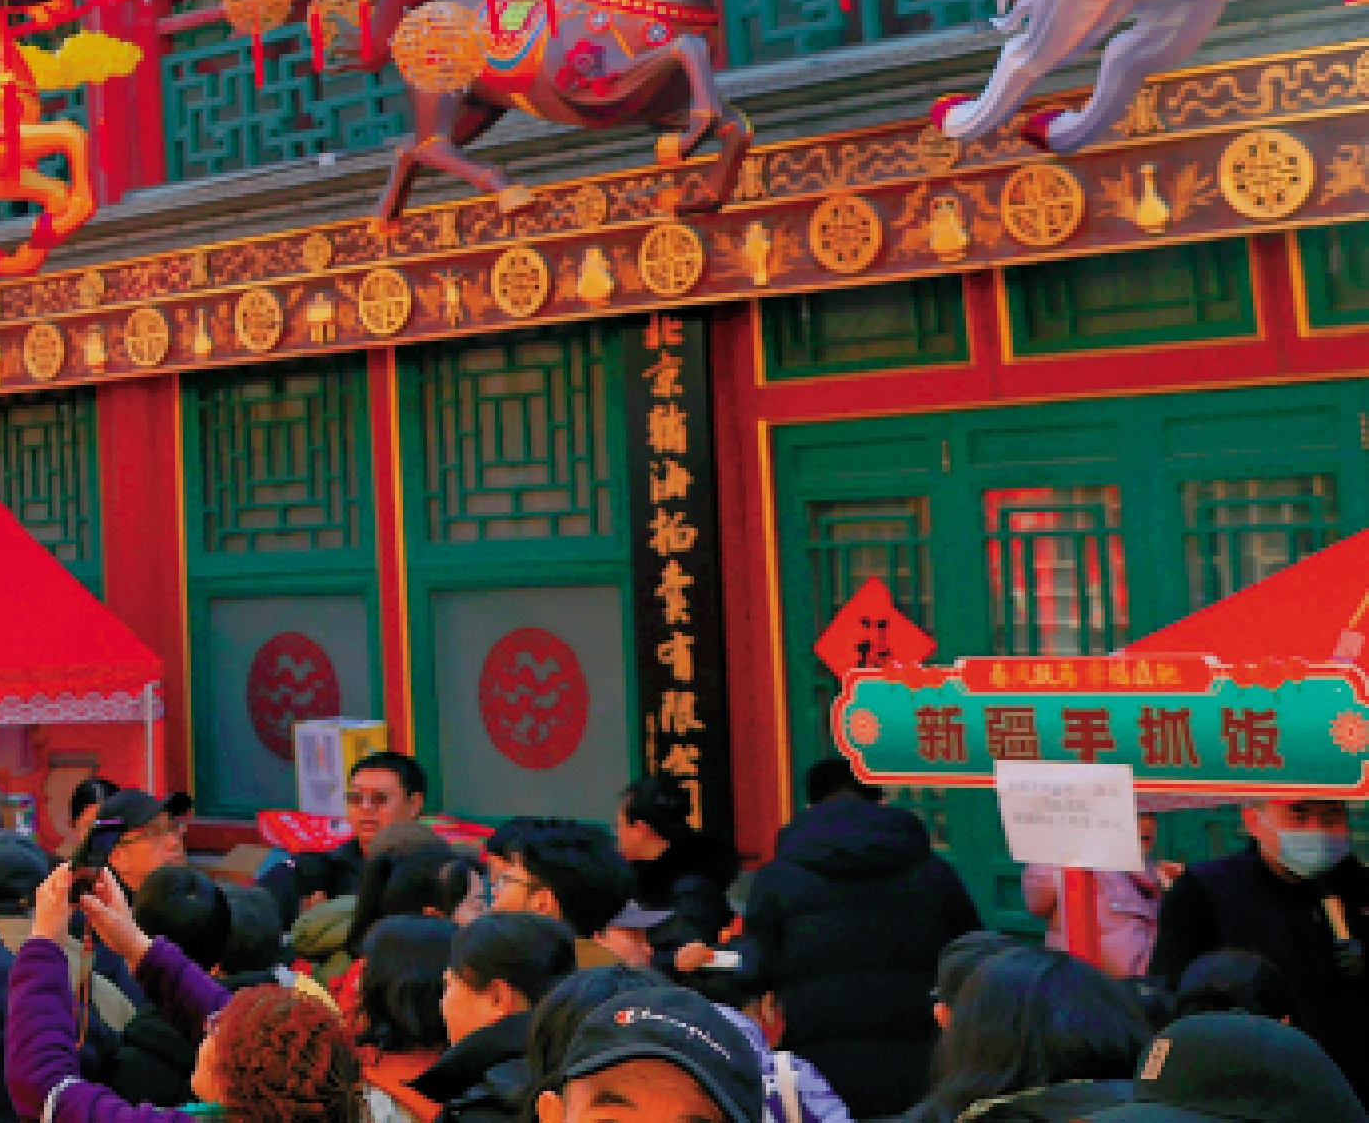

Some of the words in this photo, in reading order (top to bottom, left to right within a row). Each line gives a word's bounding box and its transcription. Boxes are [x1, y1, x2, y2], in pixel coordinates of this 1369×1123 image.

[914, 704, 1285, 769] 新疆手抓饭
